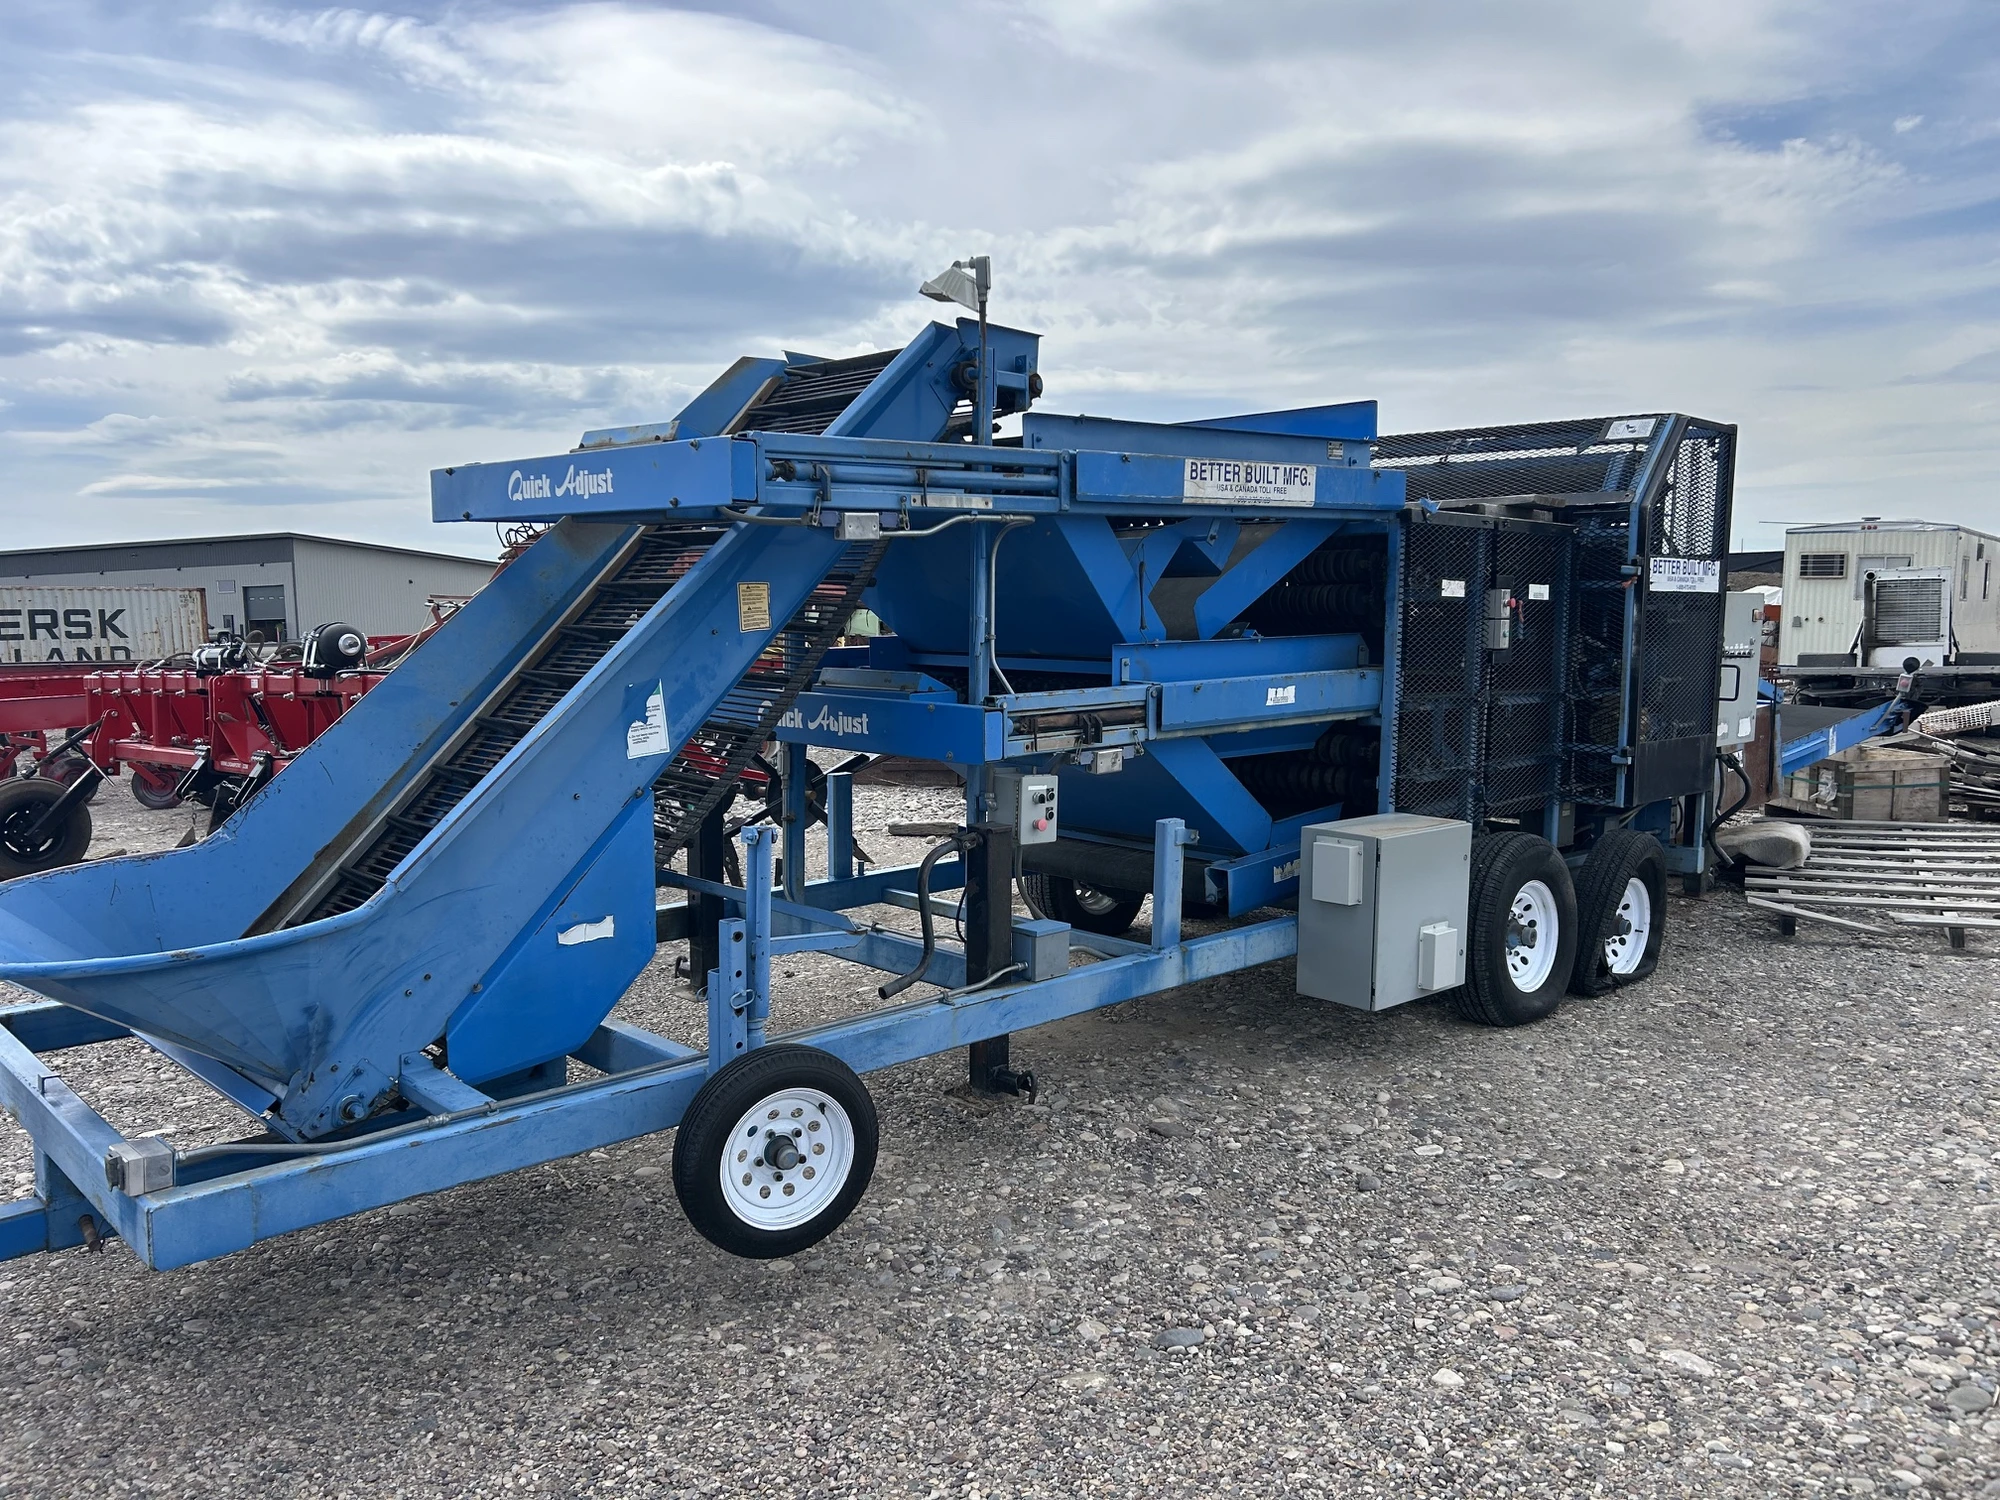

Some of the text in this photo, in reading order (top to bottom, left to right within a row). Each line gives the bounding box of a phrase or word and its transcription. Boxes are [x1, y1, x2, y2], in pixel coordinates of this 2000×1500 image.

[508, 464, 614, 501] Quick Adjust
[1190, 461, 1311, 486] BETTER BUILT MFG.
[1234, 485, 1258, 493] CANADA
[1273, 486, 1288, 494] FREE
[1653, 559, 1681, 574] BETTER
[1682, 560, 1701, 576] BUILT
